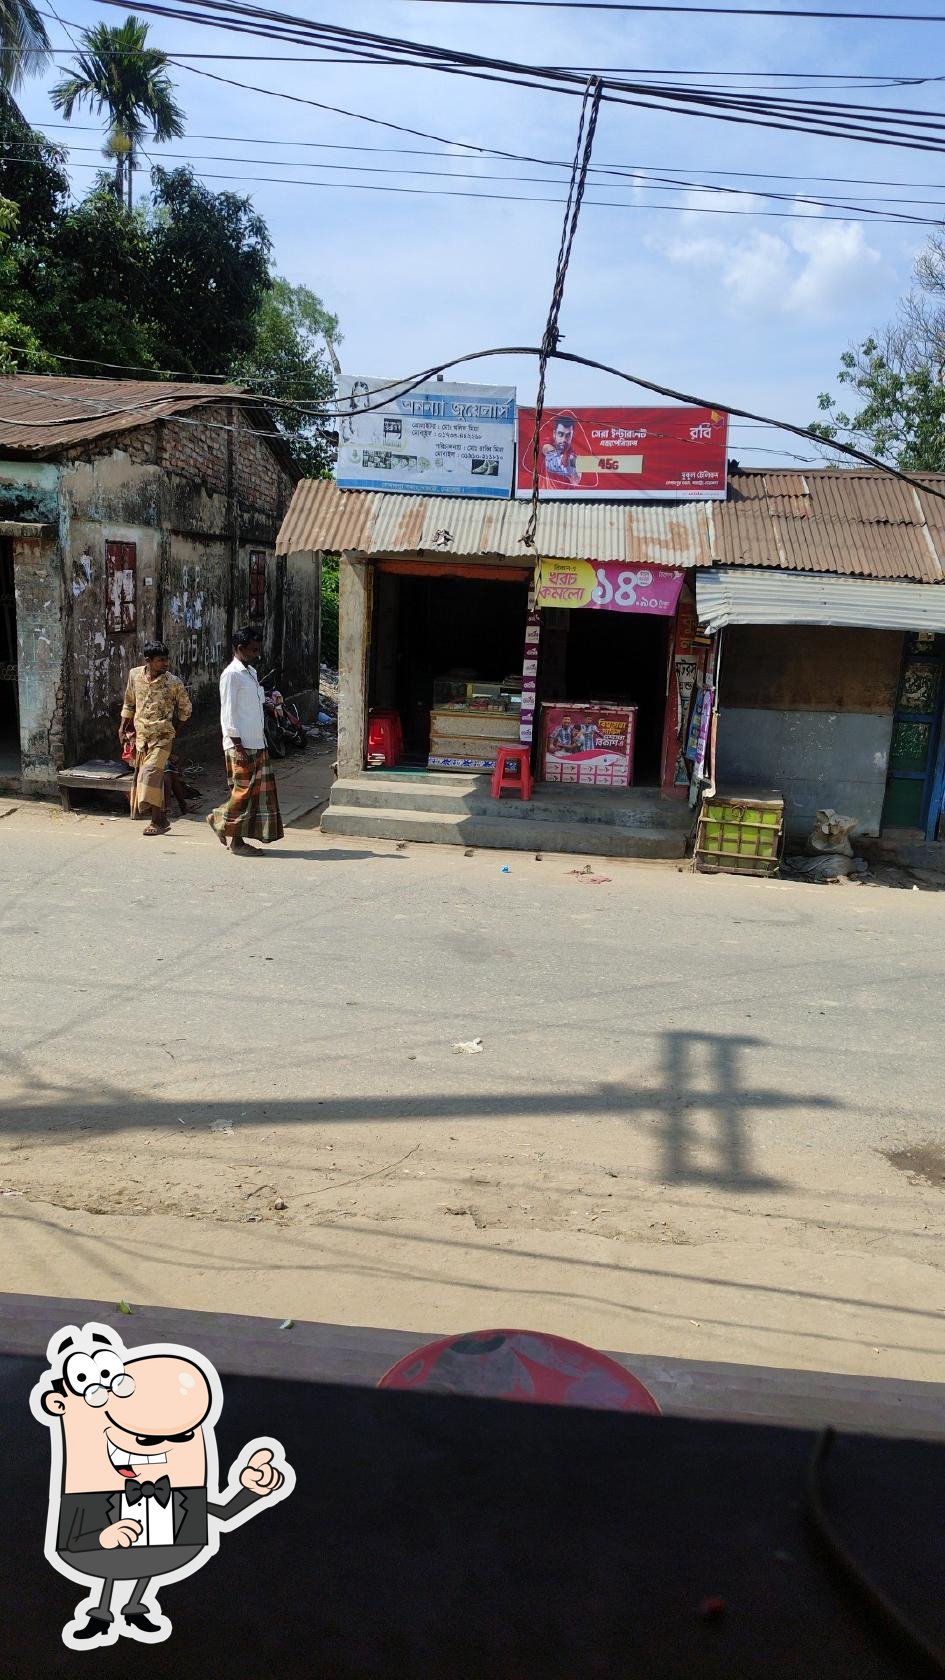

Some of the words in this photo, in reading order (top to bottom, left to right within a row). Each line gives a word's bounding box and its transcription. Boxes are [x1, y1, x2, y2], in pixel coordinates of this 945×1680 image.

[690, 422, 712, 440] রবি
[548, 572, 578, 586] খরচ
[539, 586, 585, 600] কমলো
